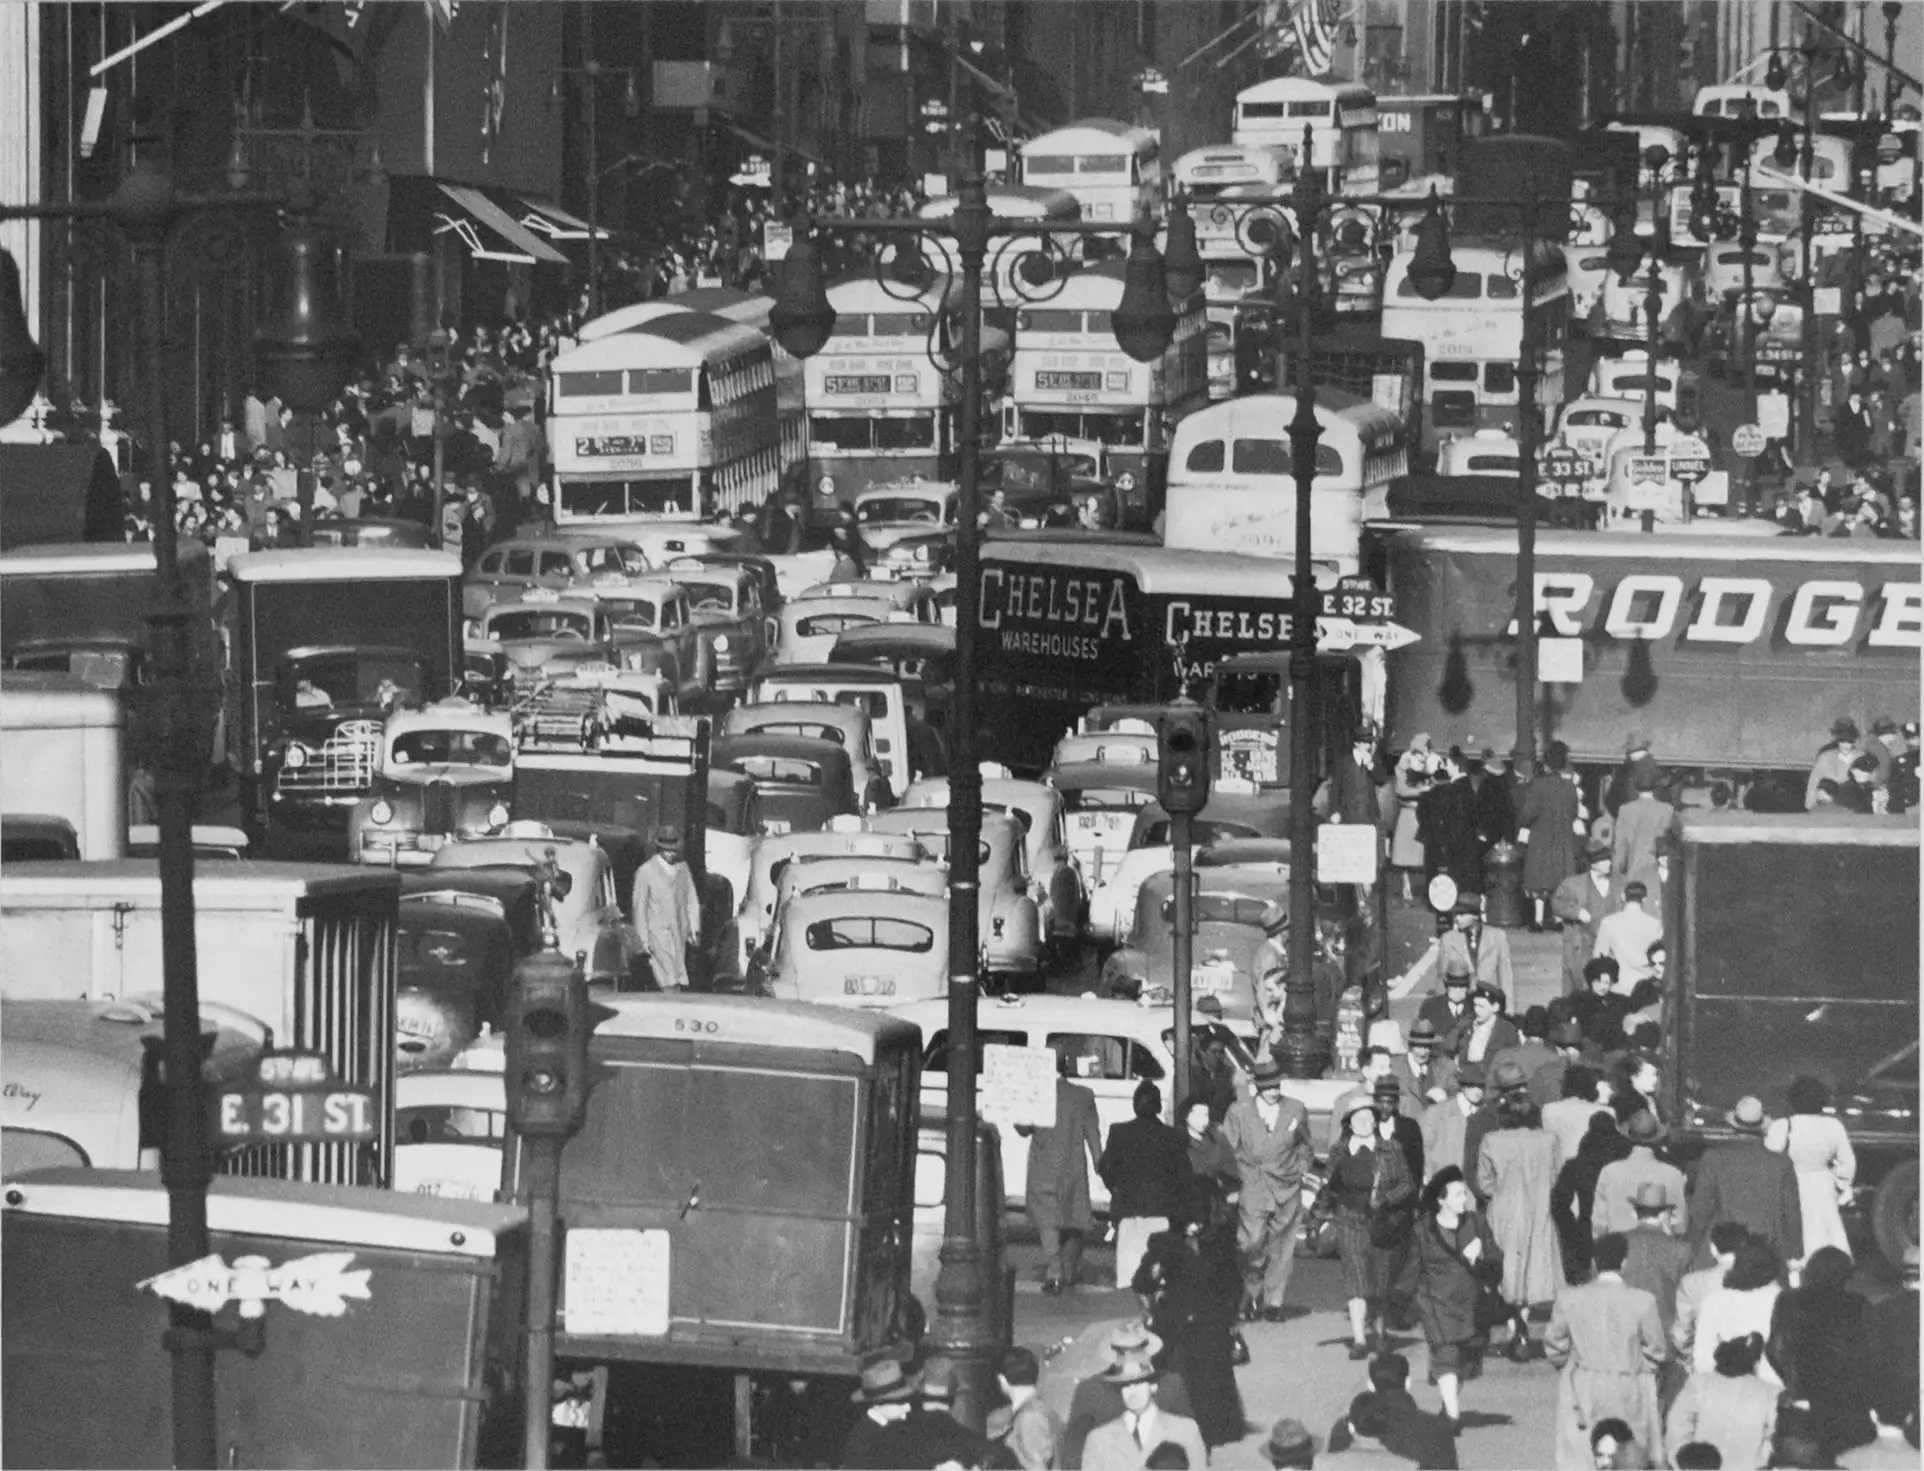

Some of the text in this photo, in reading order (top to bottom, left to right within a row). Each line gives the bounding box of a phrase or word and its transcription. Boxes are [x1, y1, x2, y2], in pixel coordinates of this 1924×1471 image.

[1552, 462, 1571, 476] 33
[979, 568, 1132, 640] CHELSEA
[1342, 596, 1366, 615] 32
[1001, 631, 1100, 659] WAREHOUSES
[262, 1092, 304, 1134] 31
[187, 1278, 317, 1294] ONE WAY
